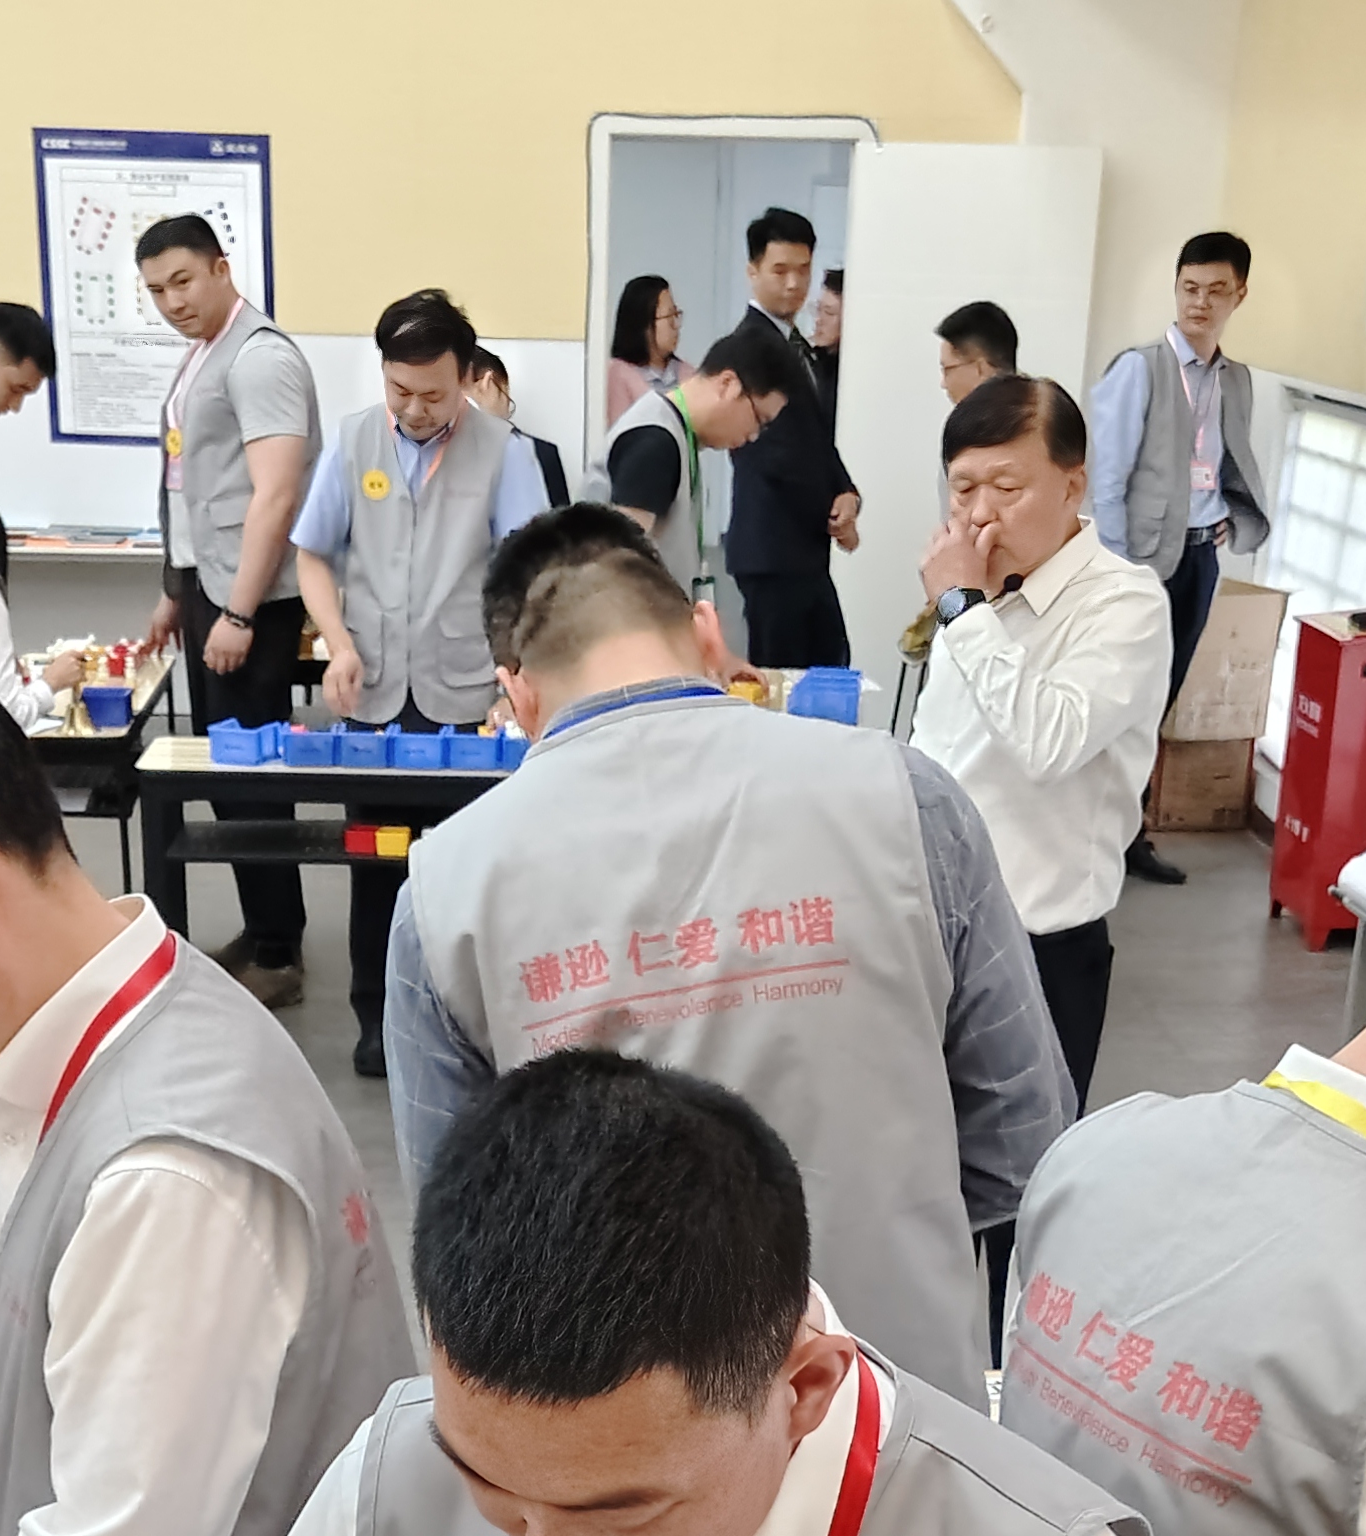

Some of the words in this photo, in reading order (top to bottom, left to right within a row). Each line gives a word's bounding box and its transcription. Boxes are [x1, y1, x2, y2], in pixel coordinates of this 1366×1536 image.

[520, 939, 610, 1002] 谦逊
[627, 917, 720, 976] 仁爱
[737, 896, 834, 954] 和谐
[752, 976, 843, 1005] Harmony
[1075, 1310, 1155, 1393] 仁爱
[1157, 1360, 1263, 1451] 和谐
[1138, 1442, 1235, 1508] Harmony
